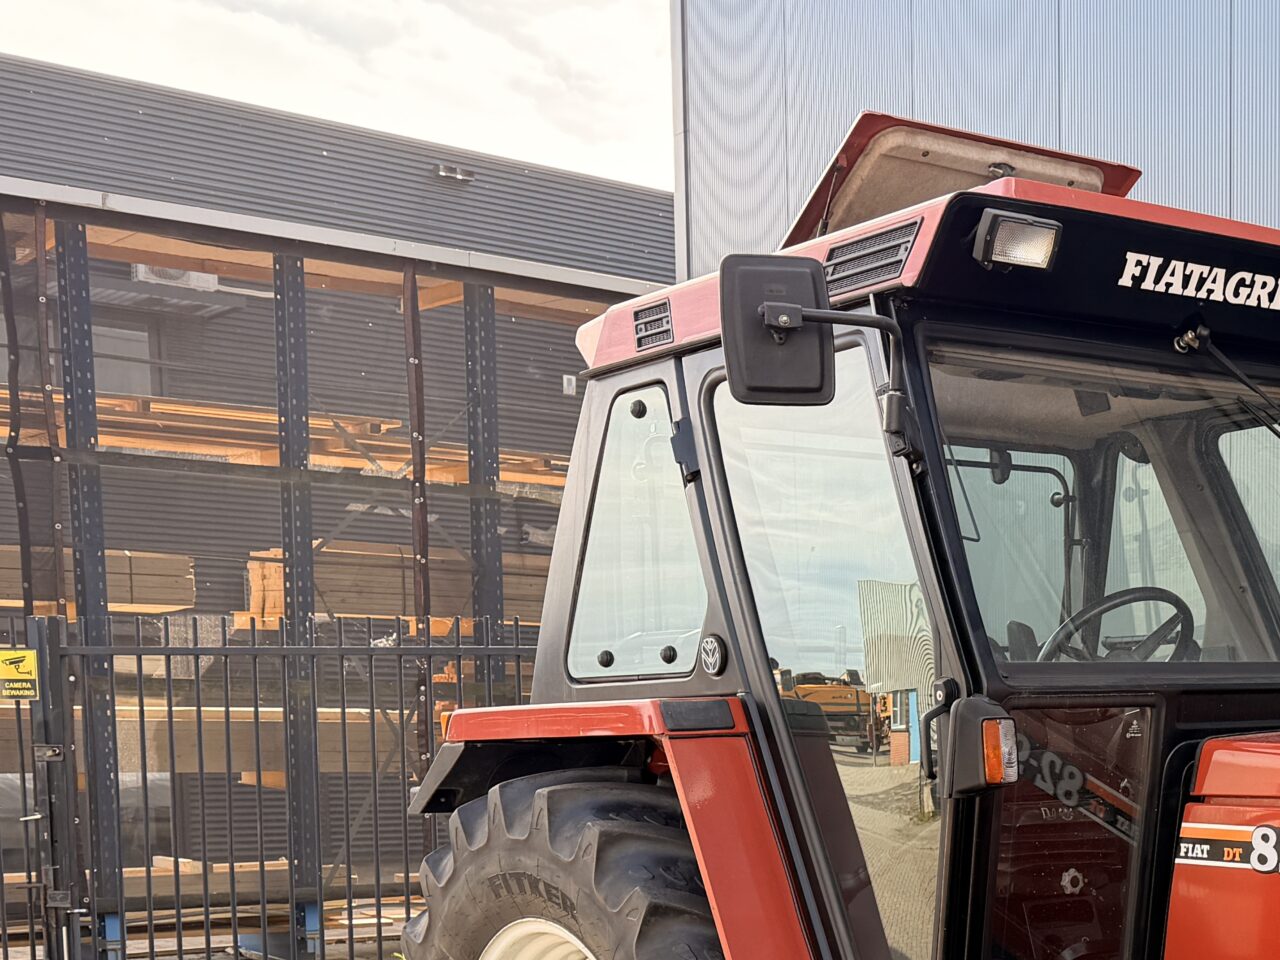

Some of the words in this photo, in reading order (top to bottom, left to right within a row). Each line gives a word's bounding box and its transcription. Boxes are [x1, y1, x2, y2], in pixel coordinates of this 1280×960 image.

[4, 681, 32, 689] CAMERA
[1179, 843, 1210, 858] FIAT
[1223, 847, 1243, 862] DT
